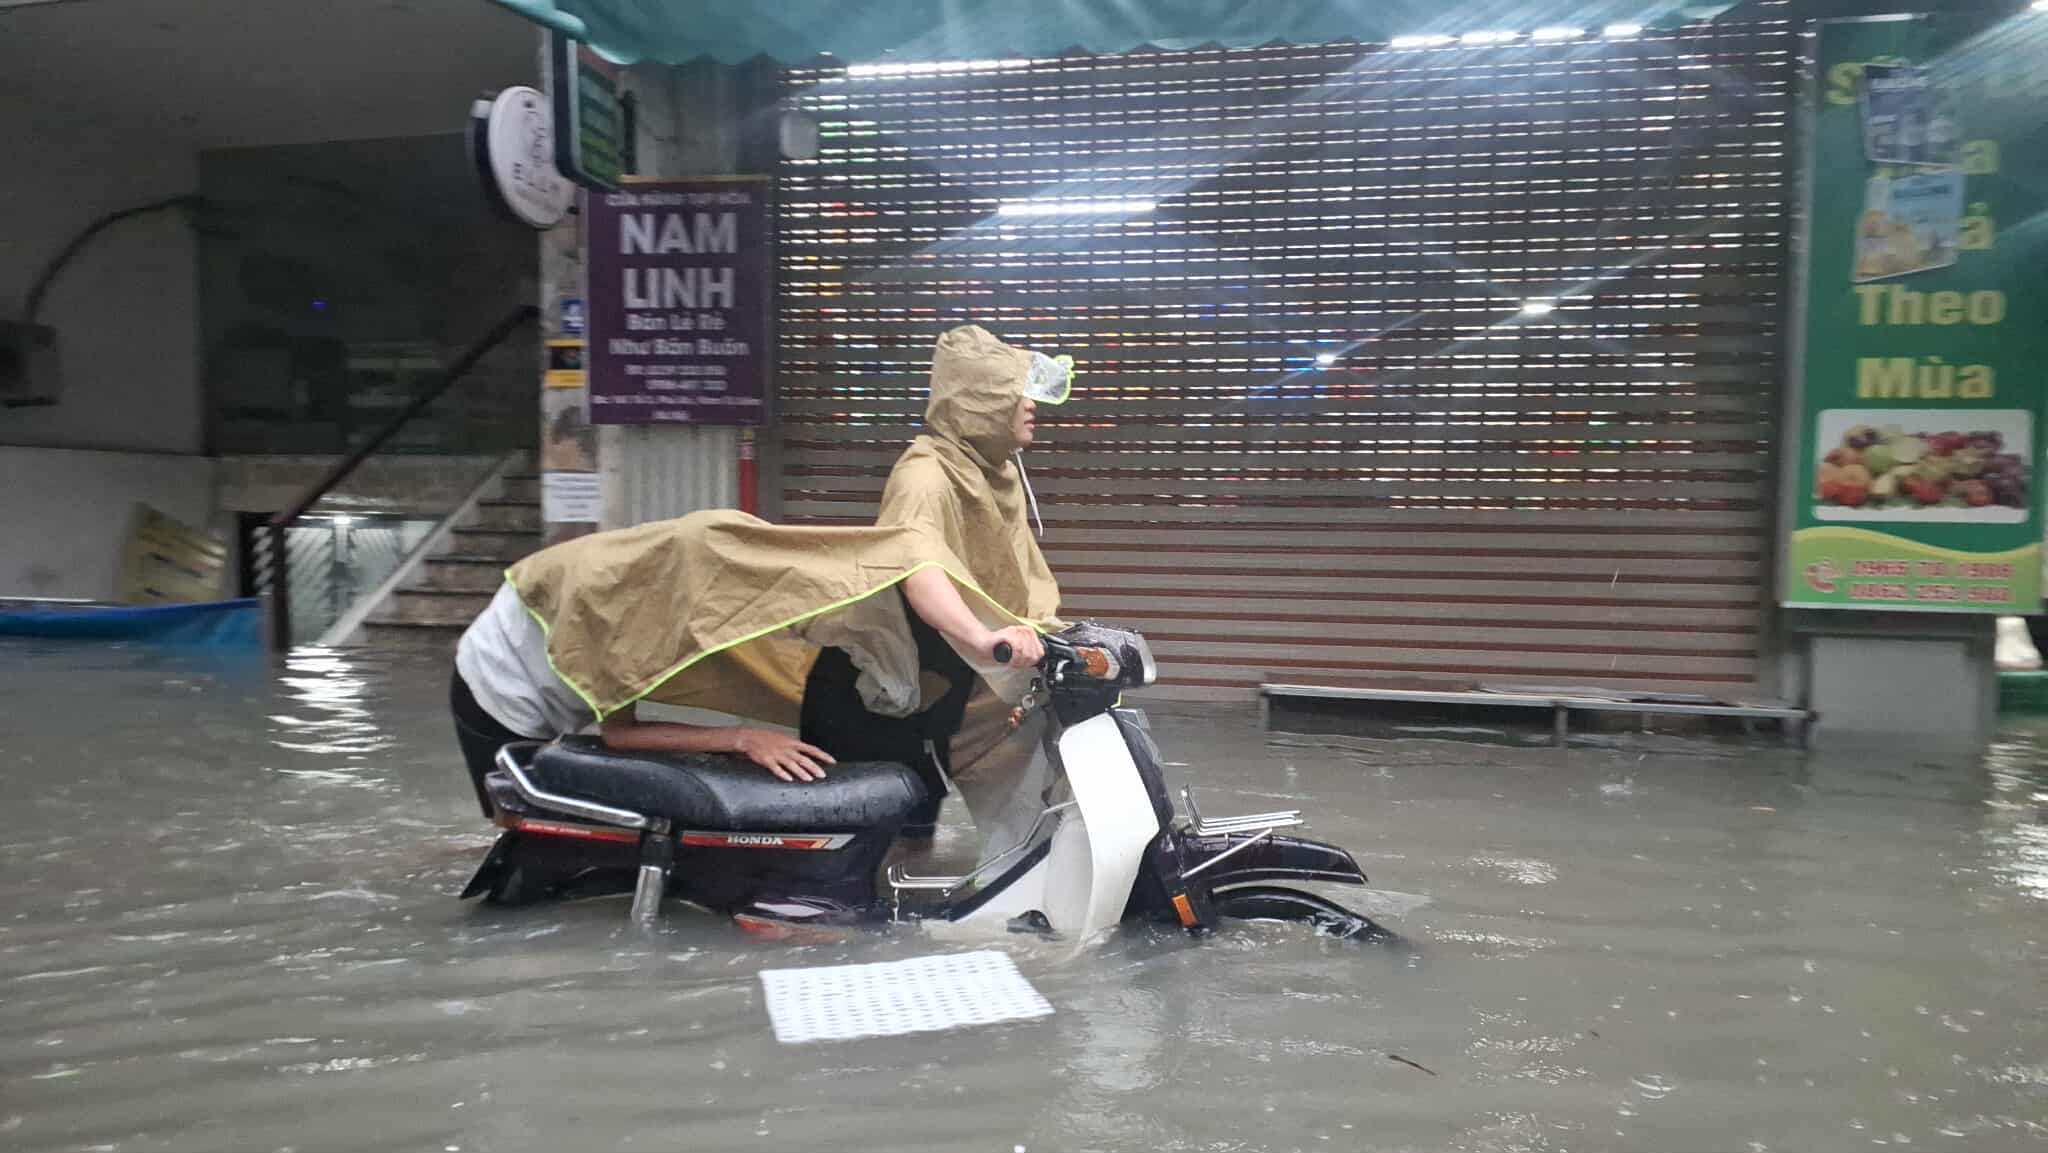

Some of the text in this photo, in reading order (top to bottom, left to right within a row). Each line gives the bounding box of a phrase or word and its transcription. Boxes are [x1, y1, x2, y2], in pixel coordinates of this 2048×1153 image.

[620, 212, 738, 254] NAM
[622, 267, 736, 309] LINH
[1855, 283, 2006, 325] Theo
[1856, 355, 1995, 398] Mùa
[728, 834, 784, 846] HONDA
